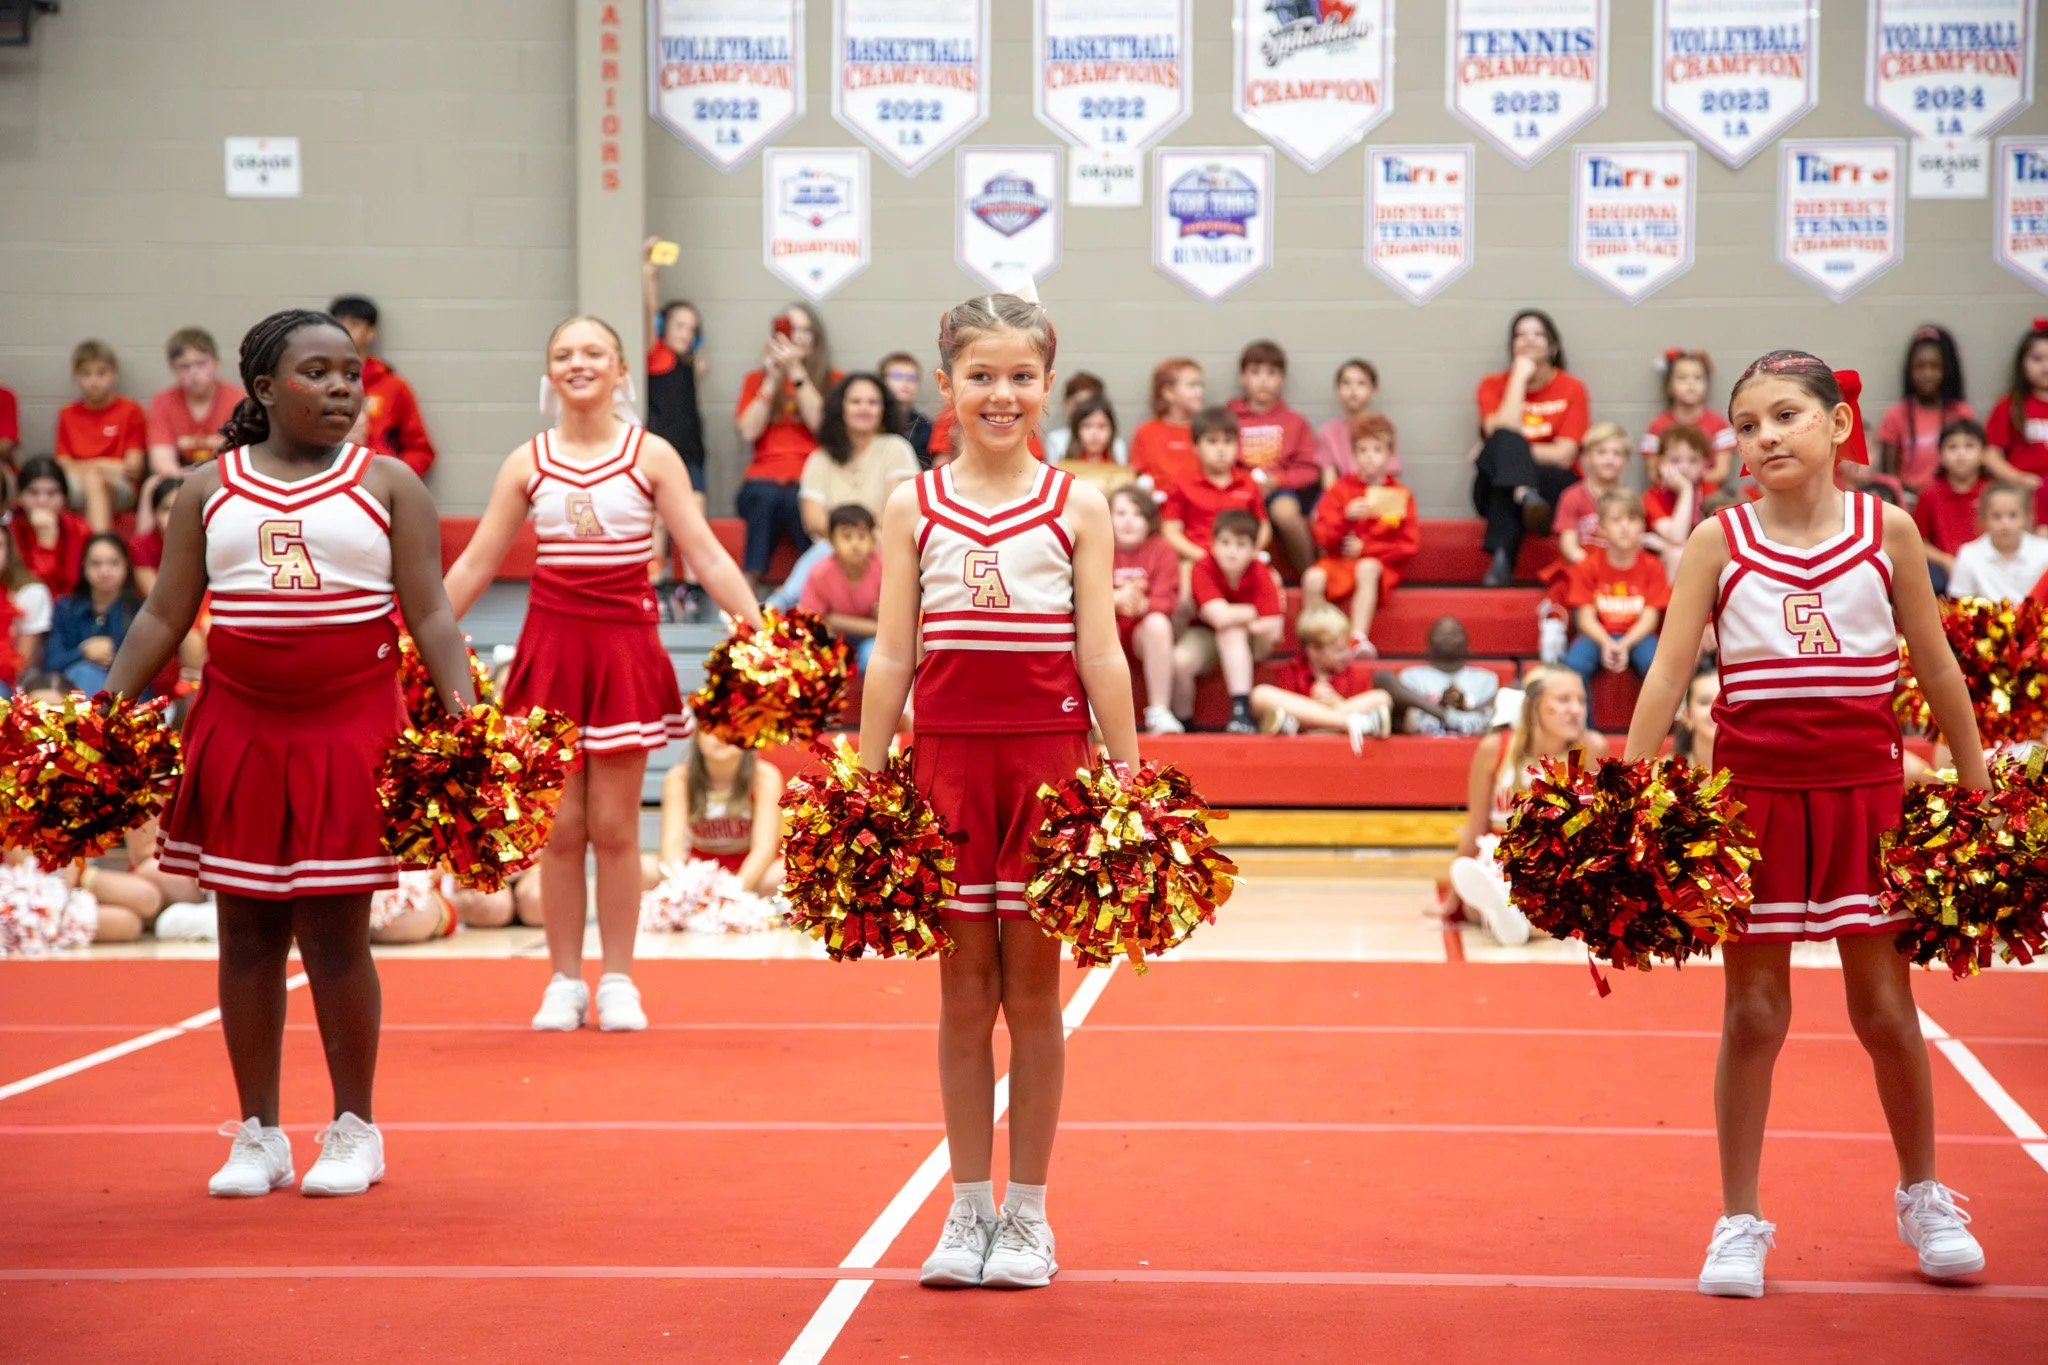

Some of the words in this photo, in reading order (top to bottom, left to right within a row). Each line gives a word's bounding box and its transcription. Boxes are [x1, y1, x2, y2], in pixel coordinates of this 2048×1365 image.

[661, 36, 789, 61] VOLLEYBALL
[846, 37, 973, 63] BASKETBALL
[1048, 35, 1176, 60] BASKETBALL
[1463, 27, 1594, 54] TENNIS
[1669, 25, 1804, 53] VOLLEYBALL
[1884, 22, 2019, 50] VOLLEYBALL
[661, 62, 790, 90] CHAMPION
[844, 64, 976, 92] CHAMPIONS
[1046, 61, 1180, 90] CHAMPIONS
[1459, 54, 1592, 85] CHAMPION
[1666, 53, 1803, 84] CHAMPION
[1880, 50, 2018, 81] CHAMPION
[600, 0, 622, 192] ARRIORS
[1246, 78, 1381, 107] CHAMPION
[1492, 91, 1561, 114] 2023
[1701, 90, 1770, 113] 2023
[1913, 86, 1985, 111] 2024
[693, 98, 760, 120] 2022
[877, 99, 943, 121] 2022
[1079, 97, 1146, 119] 2022
[1379, 223, 1462, 238] TENNIS
[1794, 216, 1888, 233] TENNIS
[565, 493, 604, 537] CA
[258, 519, 321, 590] CA
[963, 549, 1010, 608] CA
[1783, 592, 1841, 654] CA
